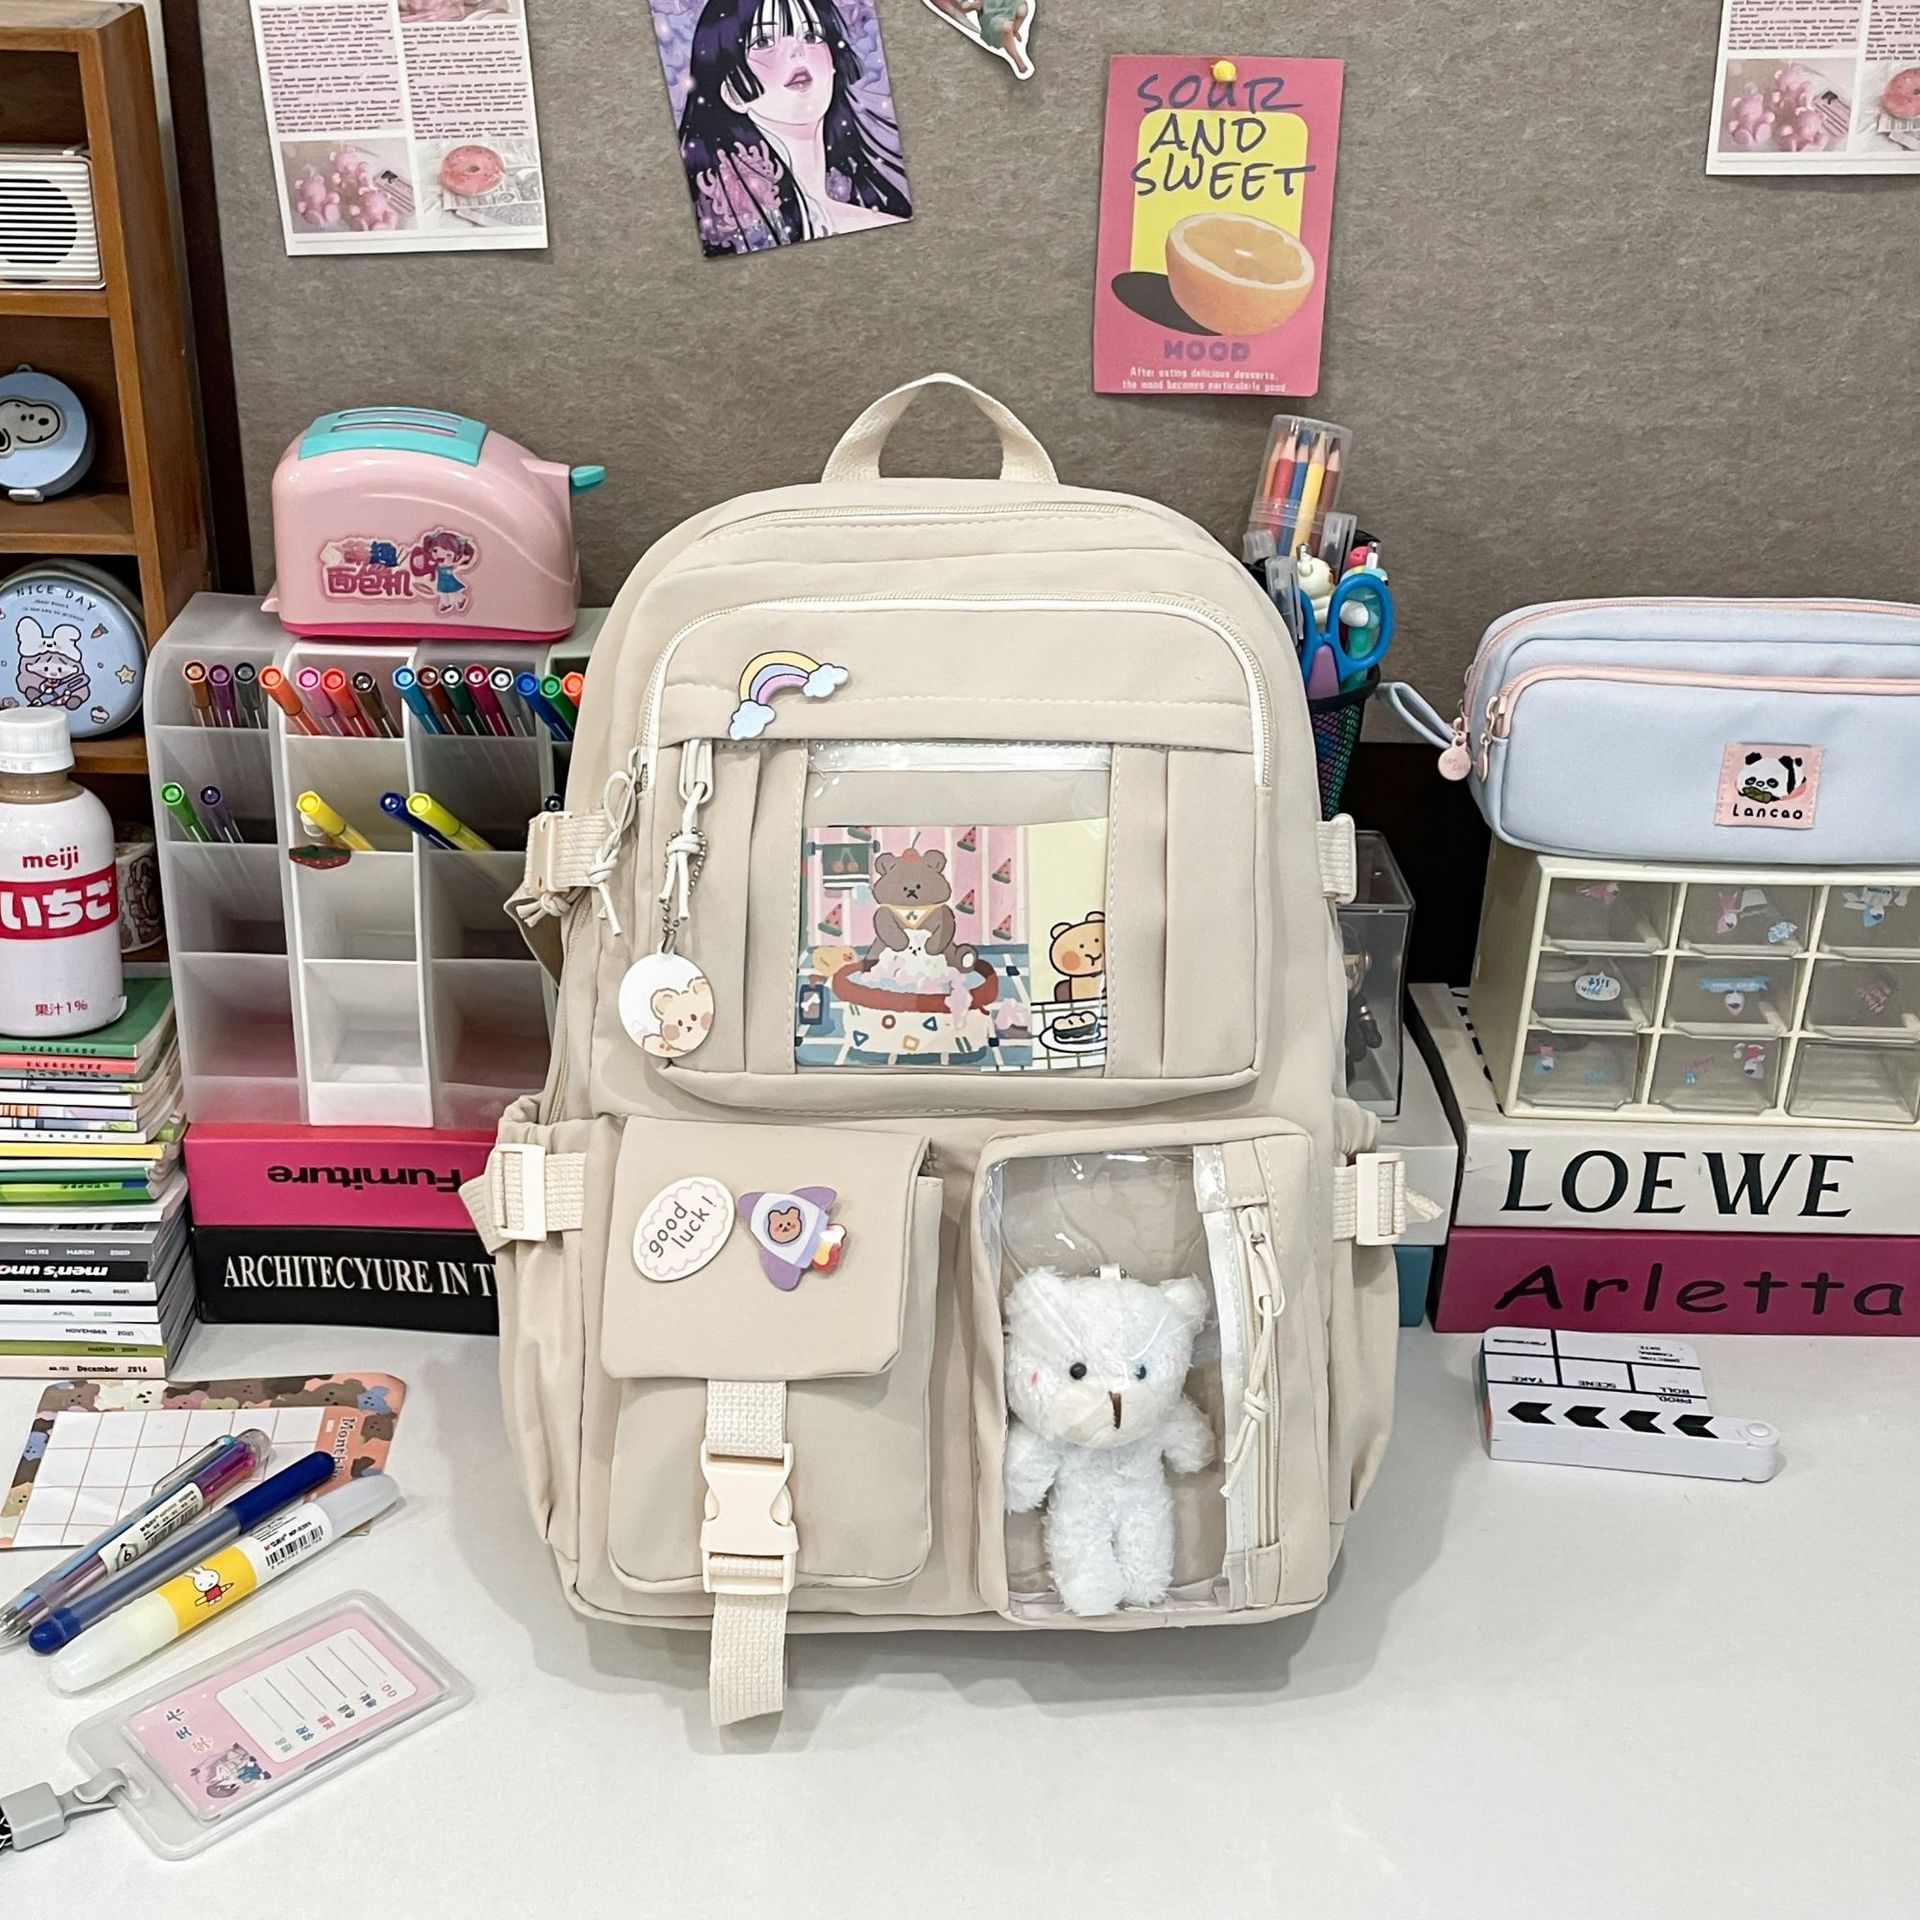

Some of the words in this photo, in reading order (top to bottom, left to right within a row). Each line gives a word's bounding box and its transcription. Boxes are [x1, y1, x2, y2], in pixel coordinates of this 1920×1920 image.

[1137, 74, 1304, 113] SOUR
[1149, 113, 1266, 157] AND
[1131, 153, 1317, 201] SWEET
[1163, 340, 1252, 362] MOOD
[1122, 379, 1137, 389] the
[1130, 366, 1154, 378] After
[1158, 368, 1188, 379] eating
[1191, 368, 1230, 379] delicious
[16, 584, 55, 597] NICE
[65, 588, 98, 611] DAY
[1732, 803, 1803, 820] Lancao
[22, 845, 79, 871] meiji
[0, 875, 113, 930] いちご
[267, 1164, 463, 1194] Furniture
[1500, 1148, 1855, 1218] LOEWE
[648, 1200, 689, 1259] good
[65, 1248, 95, 1256] MARCH
[43, 1265, 108, 1279] men's
[223, 1254, 434, 1294] ARCHITECYURE
[436, 1260, 473, 1297] IN
[1494, 1262, 1905, 1317] Arletta
[65, 1328, 108, 1336] NOVEMBER
[76, 1364, 119, 1373] December
[1511, 1375, 1545, 1384] TAKE
[1578, 1379, 1617, 1389] SCENE
[1659, 1386, 1691, 1395] ROLL
